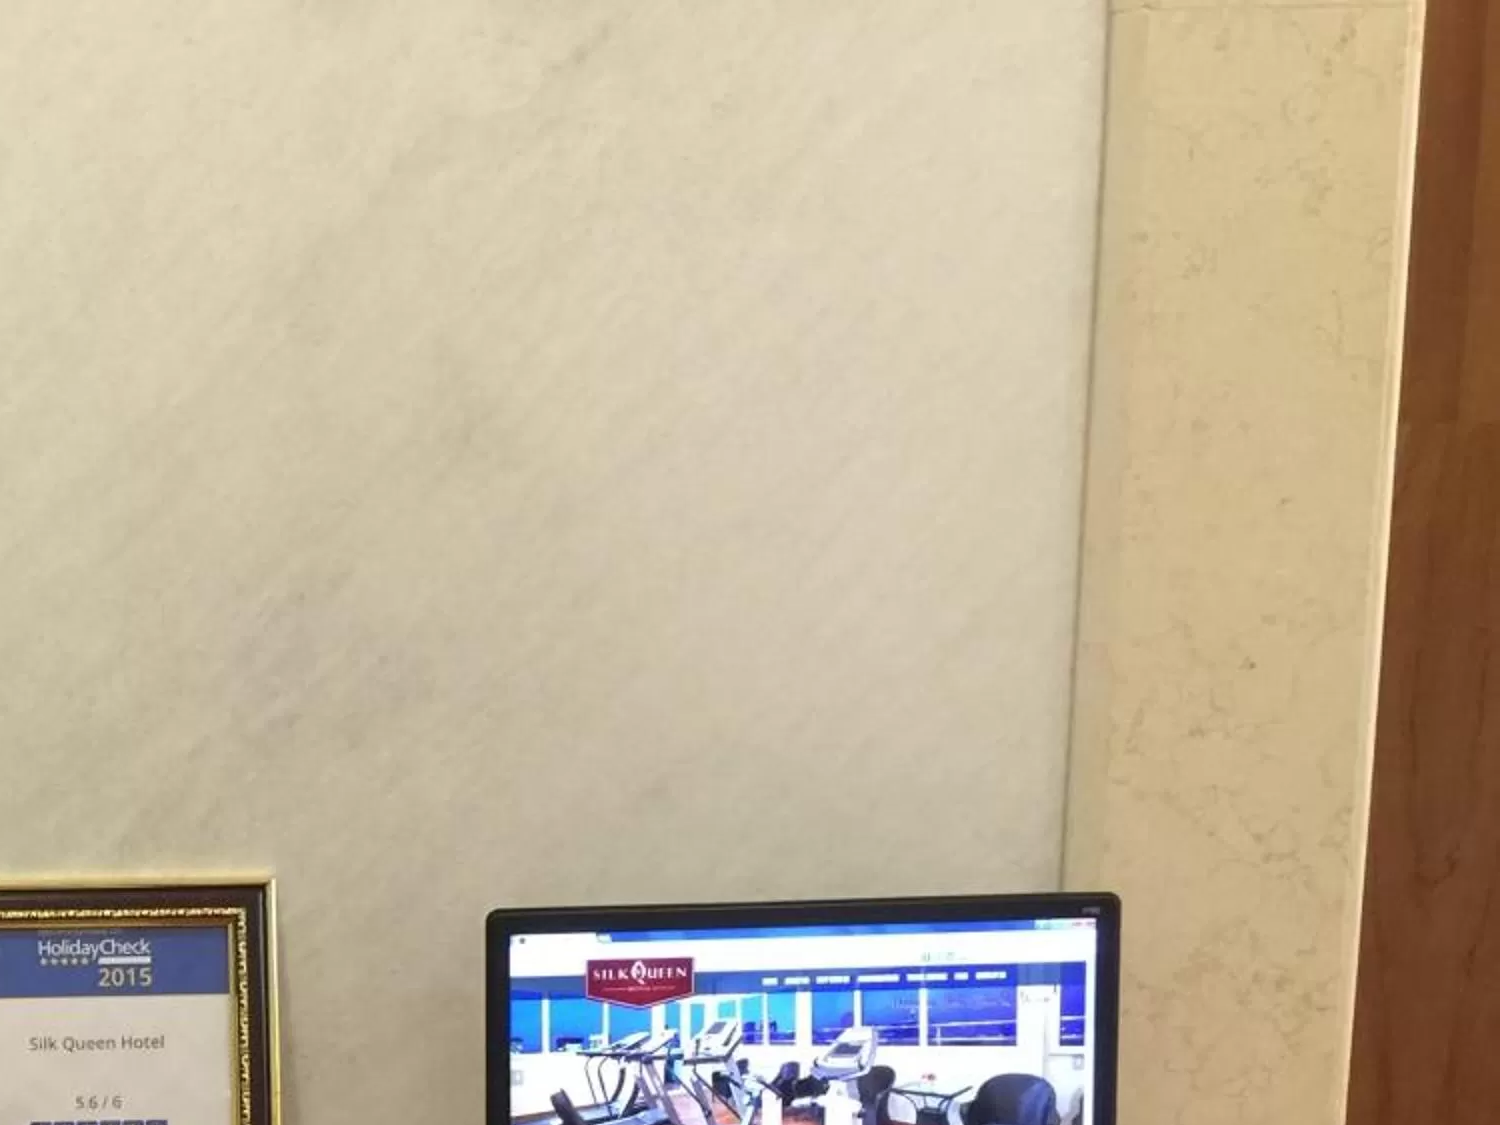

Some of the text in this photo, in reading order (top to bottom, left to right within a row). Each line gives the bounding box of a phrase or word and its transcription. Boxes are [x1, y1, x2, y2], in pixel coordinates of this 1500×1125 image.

[37, 938, 151, 961] HolidayCheck
[98, 967, 152, 988] 2015
[28, 1034, 165, 1052] Silk Queen Hotel
